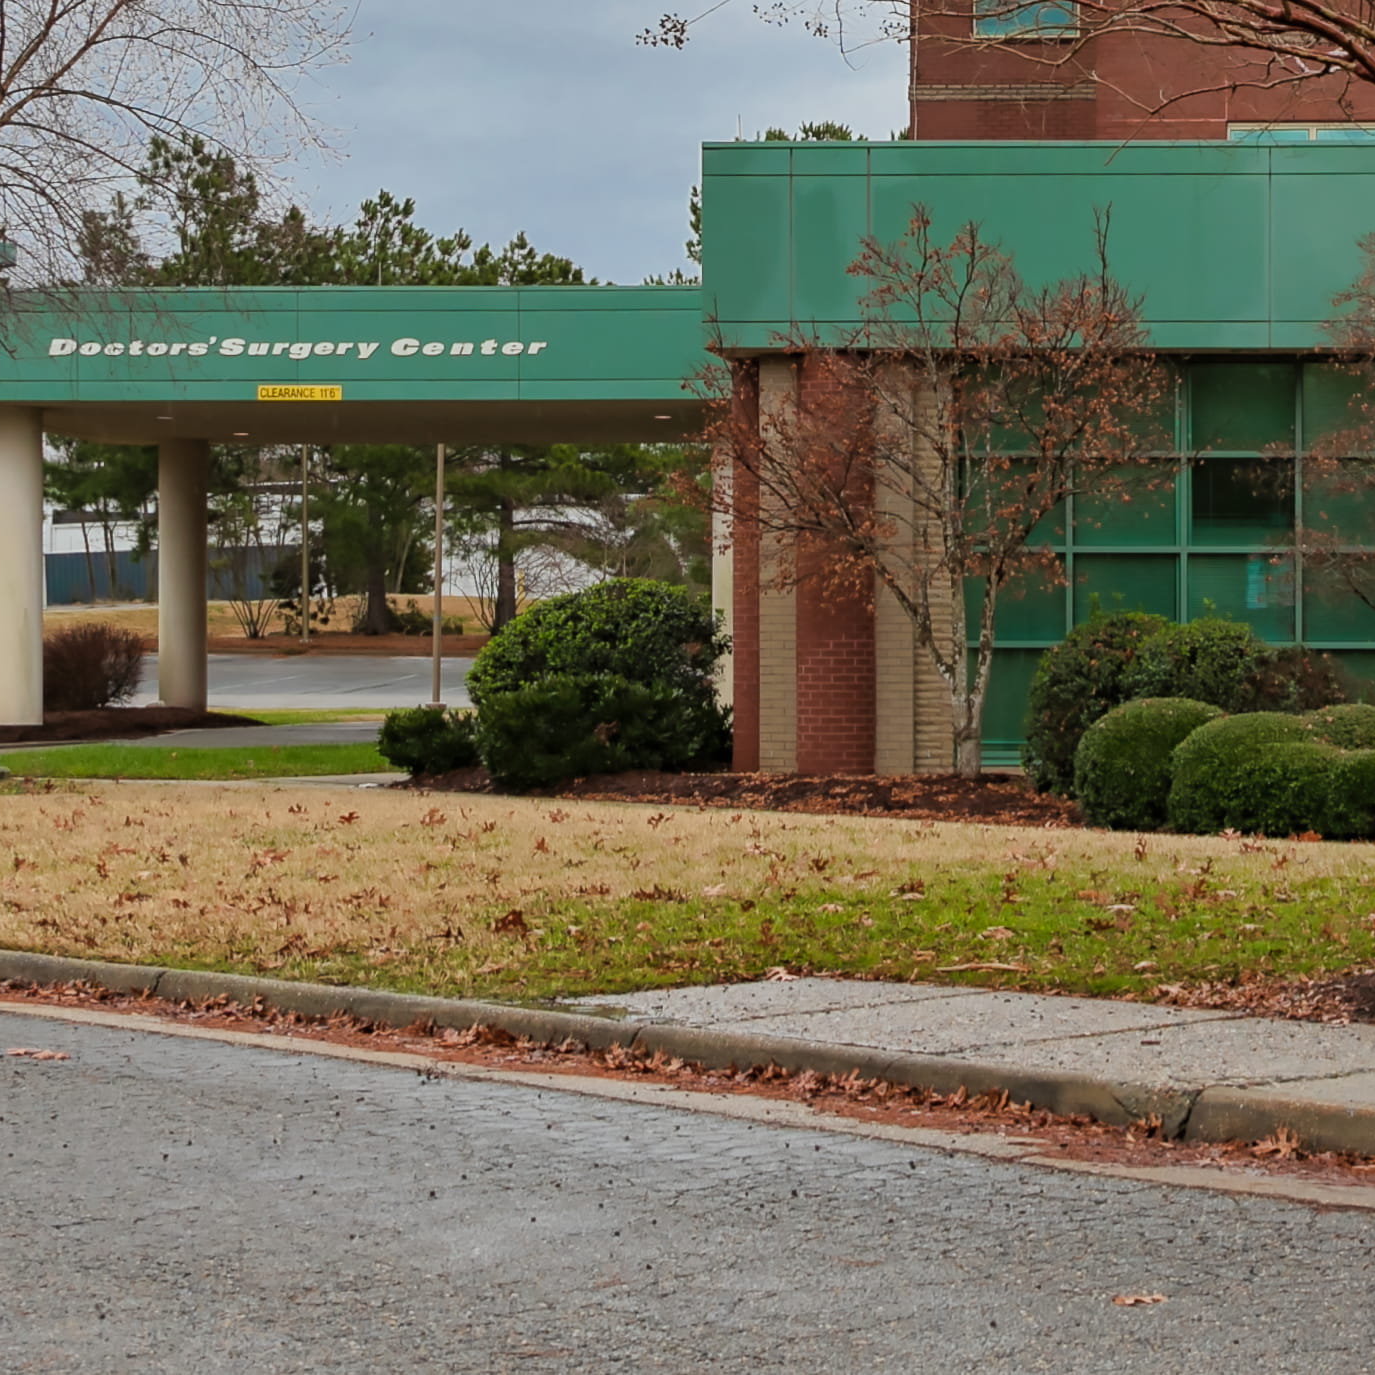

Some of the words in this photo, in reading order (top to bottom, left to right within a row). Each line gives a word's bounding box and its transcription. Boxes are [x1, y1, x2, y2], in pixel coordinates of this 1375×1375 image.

[48, 335, 217, 356] Doctors'
[219, 337, 380, 360] Surgery
[390, 337, 547, 357] Center
[259, 387, 316, 399] CLEARANCE
